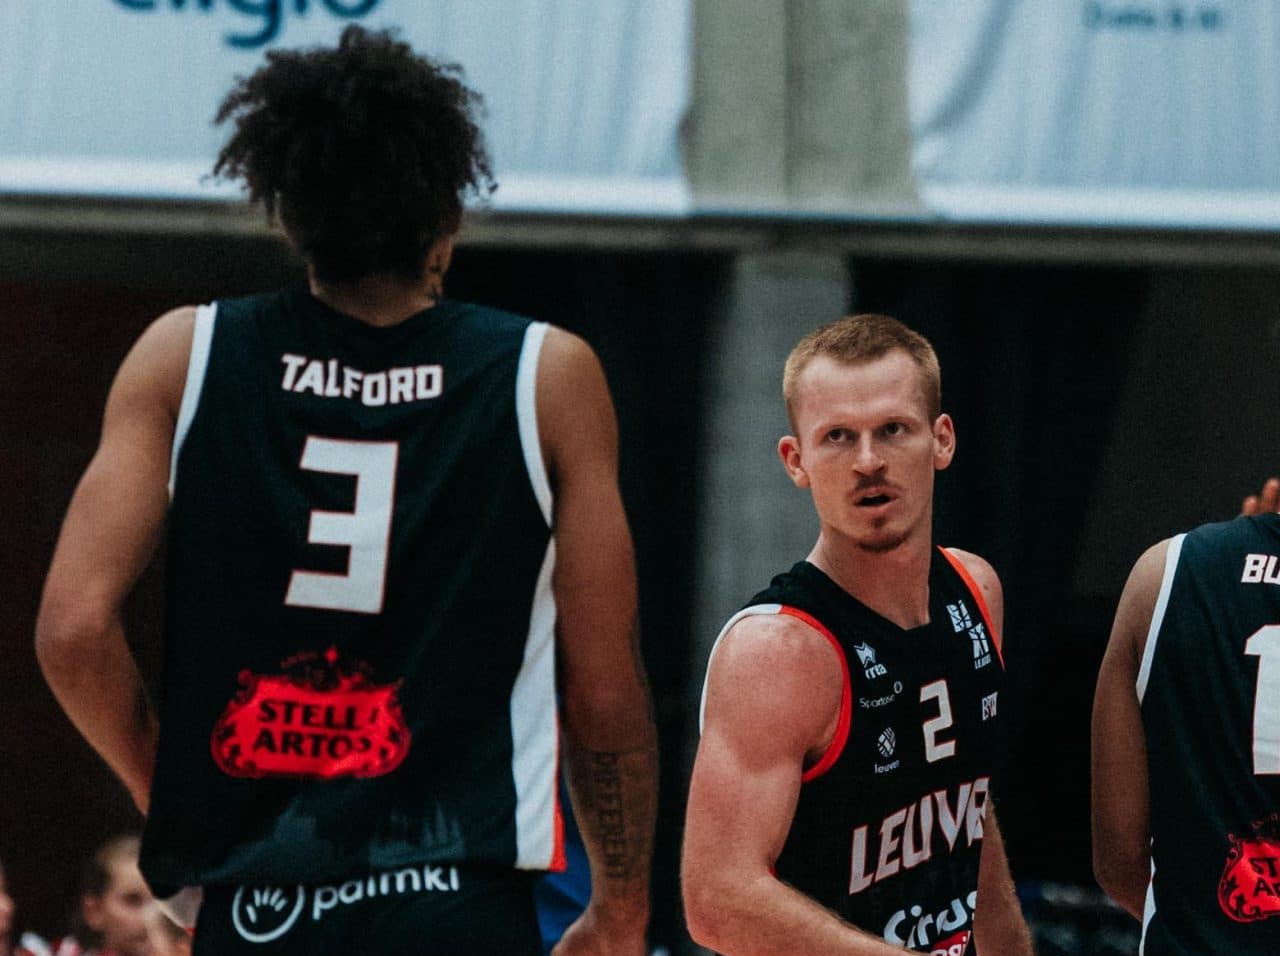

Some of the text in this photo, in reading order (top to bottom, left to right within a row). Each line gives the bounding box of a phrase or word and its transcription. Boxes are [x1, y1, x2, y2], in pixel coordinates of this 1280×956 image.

[281, 353, 443, 407] TALFORD
[285, 435, 398, 614] 3
[919, 679, 957, 763] 2
[848, 776, 992, 893] LEUVE
